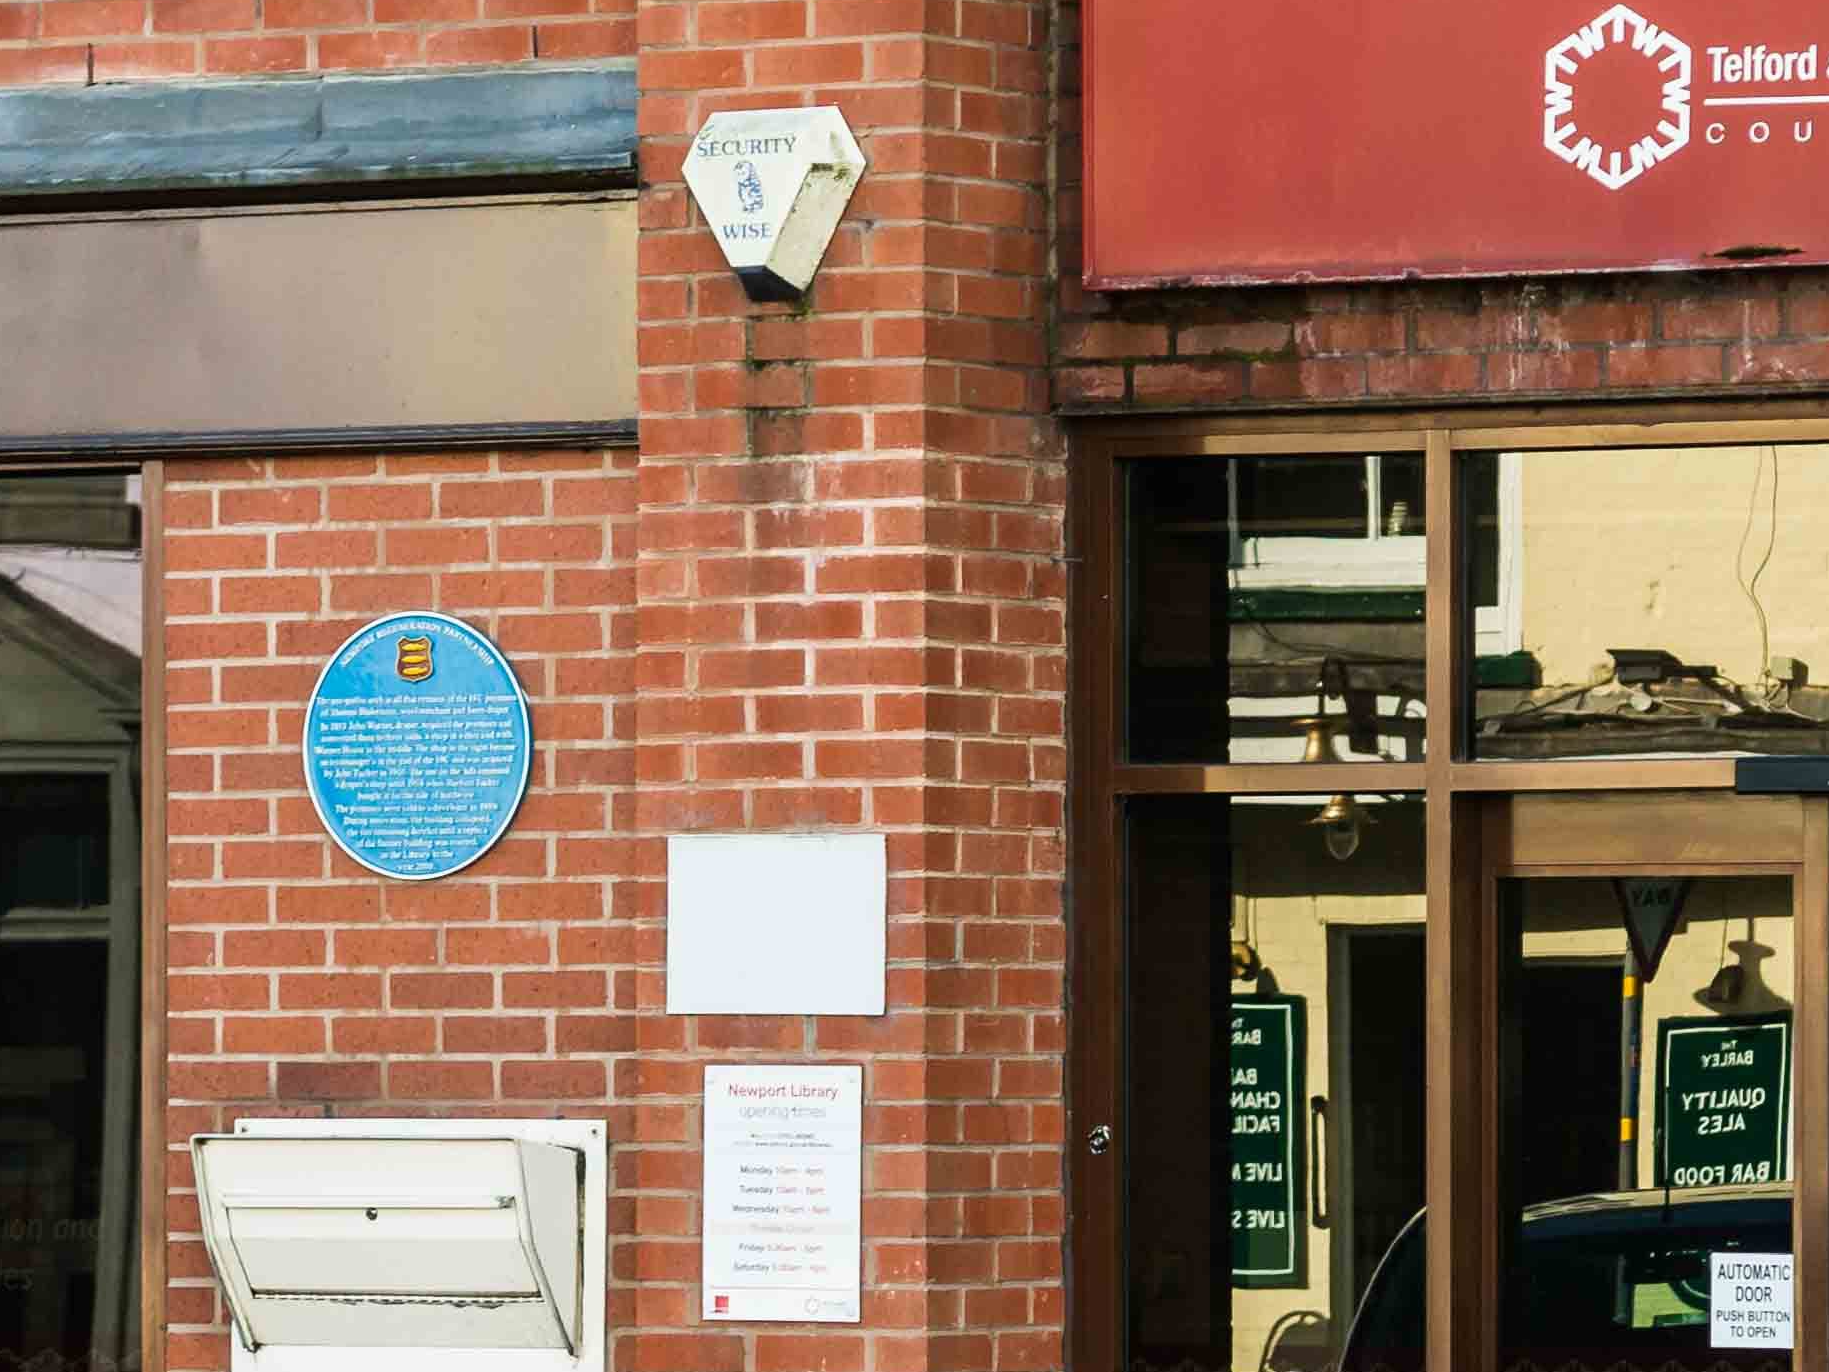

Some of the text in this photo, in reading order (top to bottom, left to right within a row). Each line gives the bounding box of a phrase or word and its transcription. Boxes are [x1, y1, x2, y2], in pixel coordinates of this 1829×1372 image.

[1706, 43, 1818, 83] Telford
[696, 135, 796, 157] SECURITY
[722, 222, 773, 240] WISE
[728, 1083, 839, 1100] Newport Library
[1718, 1263, 1791, 1281] AUTOMATIC
[1735, 1286, 1772, 1303] DOOR
[1716, 1310, 1791, 1323] PUSH BUTTON
[1730, 1325, 1777, 1339] TO OPEN
